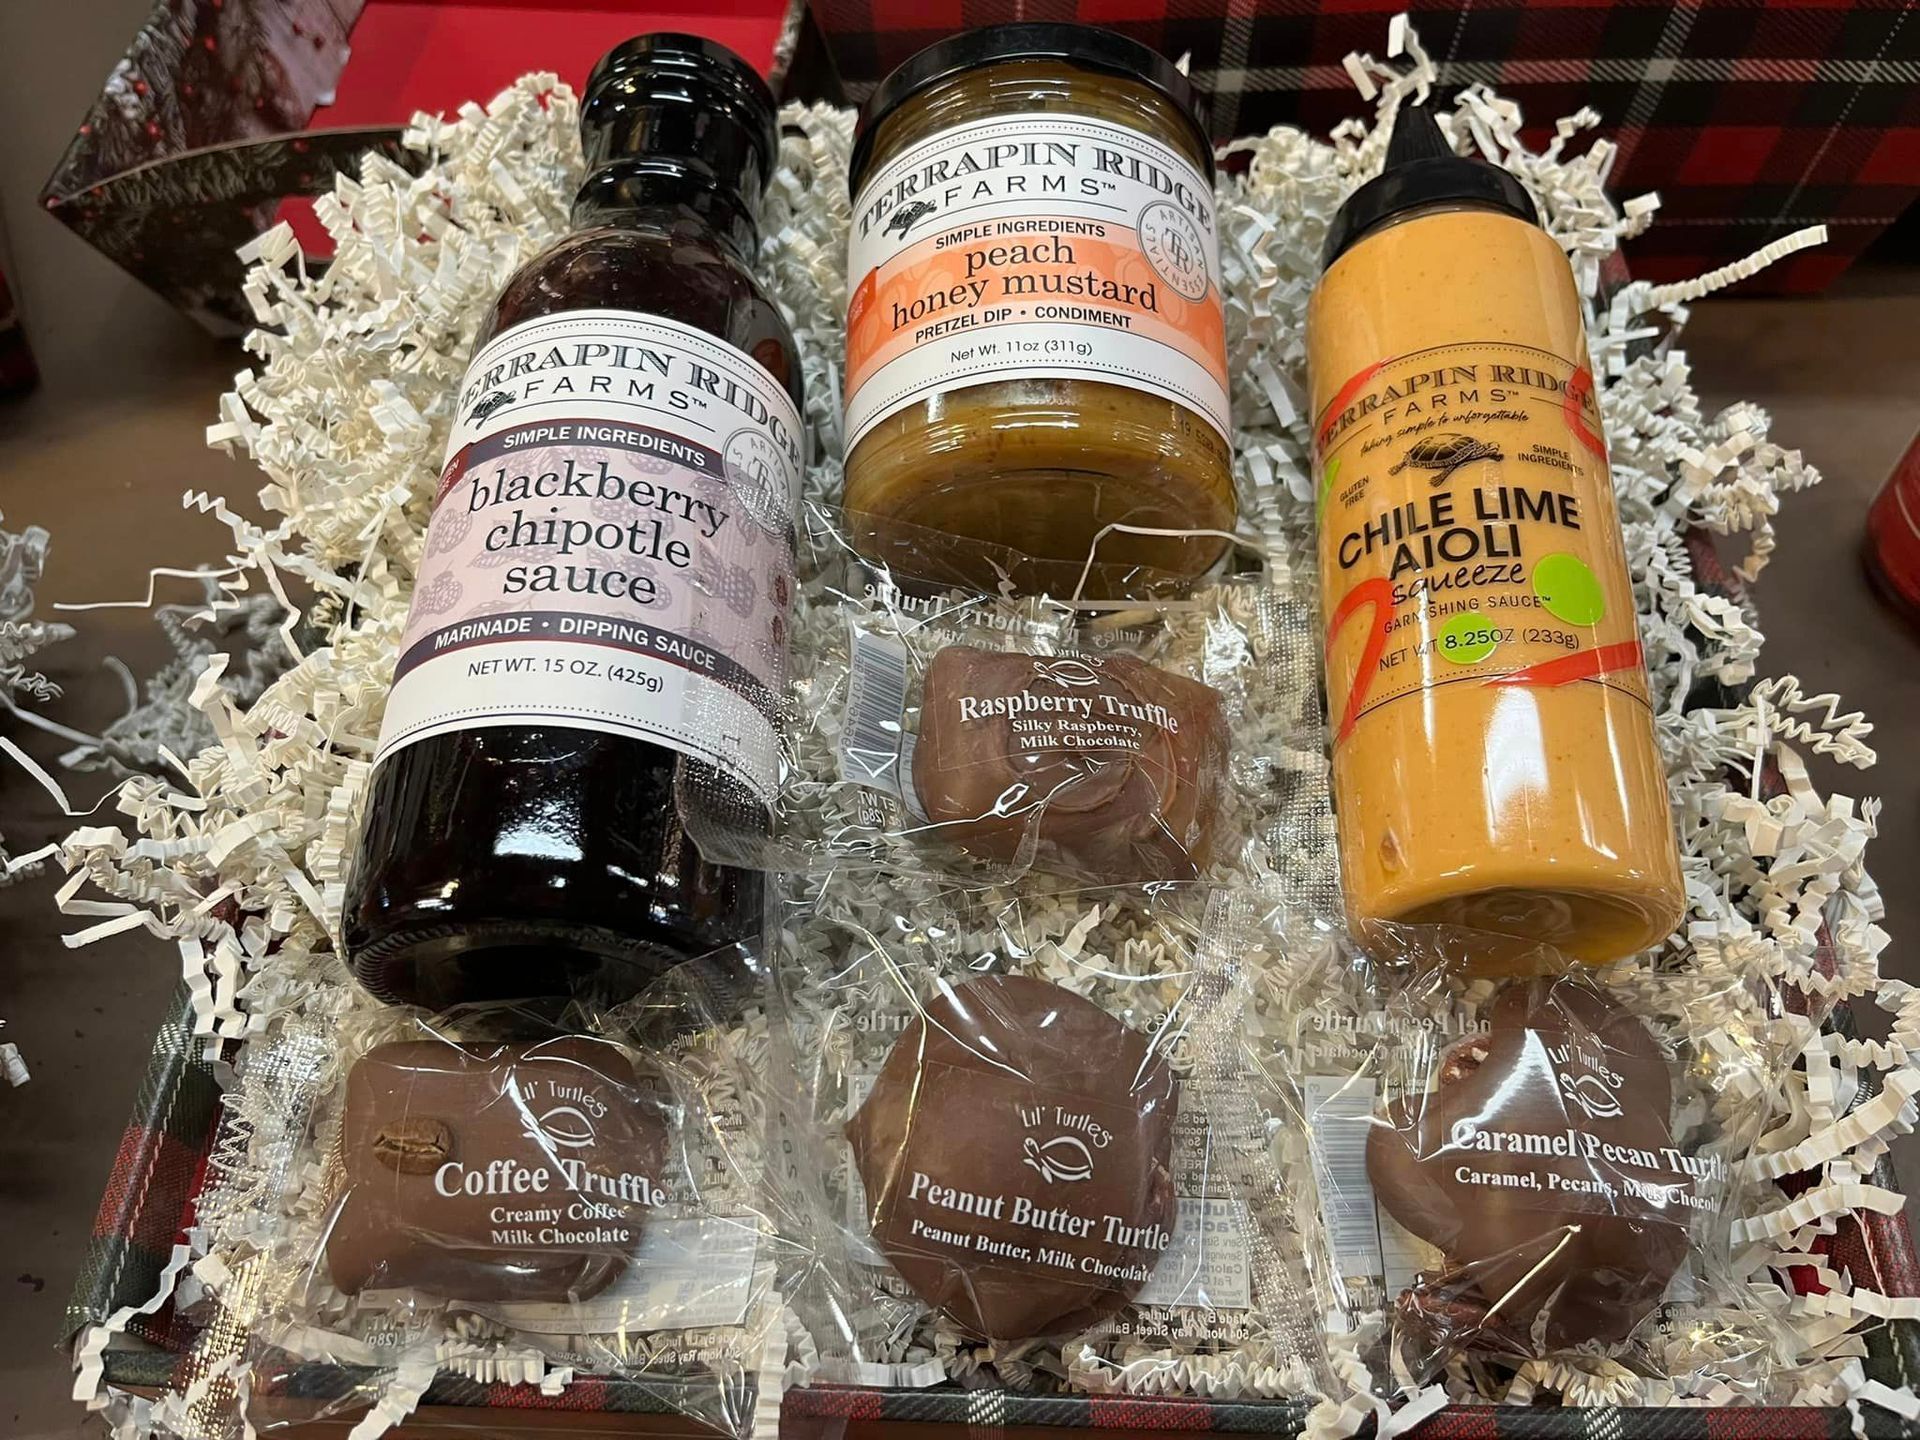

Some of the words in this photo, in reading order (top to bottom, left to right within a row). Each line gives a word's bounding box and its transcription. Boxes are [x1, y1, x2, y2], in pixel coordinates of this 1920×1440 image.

[859, 143, 1080, 241] TERRAPIN
[1092, 146, 1211, 235] RIDGE
[935, 223, 992, 250] SIMPLE
[997, 219, 1106, 239] INGREDIENTS
[965, 235, 1077, 279] peach
[891, 279, 989, 332] honey
[1002, 271, 1160, 314] mustard
[915, 315, 979, 344] PRETZEL
[984, 308, 1012, 326] DIP
[1035, 306, 1132, 329] CONDIMENT
[950, 346, 975, 364] Net
[978, 343, 1001, 356] Wt.
[1005, 339, 1040, 354] 11oz
[1044, 339, 1093, 358] (311g)
[456, 344, 677, 420] ERRAPIN
[686, 361, 799, 474] RIDGE
[1438, 411, 1448, 425] to
[503, 426, 572, 450] SIMPLE
[576, 425, 706, 467] INGREDIENTS
[1518, 452, 1584, 477] INGREDIENTS
[1532, 444, 1569, 461] SIMPLE
[467, 459, 731, 539] blackberry
[1340, 475, 1369, 502] GLUTEN
[1345, 490, 1365, 510] FREE
[484, 506, 692, 569] chipotle
[1338, 491, 1455, 570] CHILE
[1473, 487, 1581, 531] LIME
[1389, 523, 1522, 581] AIOLI
[502, 563, 657, 605] sauce
[1390, 562, 1527, 606] squeeze
[1384, 598, 1480, 634] GARNSHING
[434, 617, 532, 652] MARINADE
[559, 618, 649, 647] DIPPING
[654, 635, 717, 672] SAUCE
[1379, 648, 1408, 671] NET
[1522, 628, 1580, 650] (233g)
[467, 658, 502, 678] NET
[505, 656, 536, 673] WT.
[543, 657, 564, 674] 15
[570, 659, 602, 678] OZ.
[607, 664, 665, 694] (425g)
[958, 689, 1093, 723] Raspberry
[1098, 693, 1179, 735] Truffle
[1012, 719, 1053, 733] Silky
[1057, 719, 1143, 738] Raspberry,
[1020, 734, 1058, 749] Milk
[1062, 734, 1141, 750] Chocolate
[1576, 1045, 1624, 1090] Turtles
[547, 1080, 608, 1119] Turtles
[1021, 1106, 1046, 1128] Lil'
[1055, 1106, 1114, 1149] Turtles
[1450, 1119, 1578, 1157] Caramel
[1581, 1131, 1660, 1171] Pecan
[434, 1159, 550, 1198] Coffee
[561, 1158, 668, 1209] Truffle
[1454, 1166, 1541, 1192] Caramel,
[1548, 1173, 1619, 1198] Pecans,
[1667, 1187, 1718, 1213] Chocol
[490, 1207, 563, 1225] Creamy
[567, 1203, 628, 1220] Coffee
[907, 1171, 1006, 1221] Peanut
[1009, 1196, 1096, 1238] Butter
[1102, 1215, 1170, 1251] Turtle
[492, 1229, 535, 1245] Milk
[539, 1226, 630, 1244] Chocolate
[911, 1219, 972, 1248] Peanut
[975, 1235, 1032, 1264] Butter,
[1036, 1248, 1077, 1271] Milk
